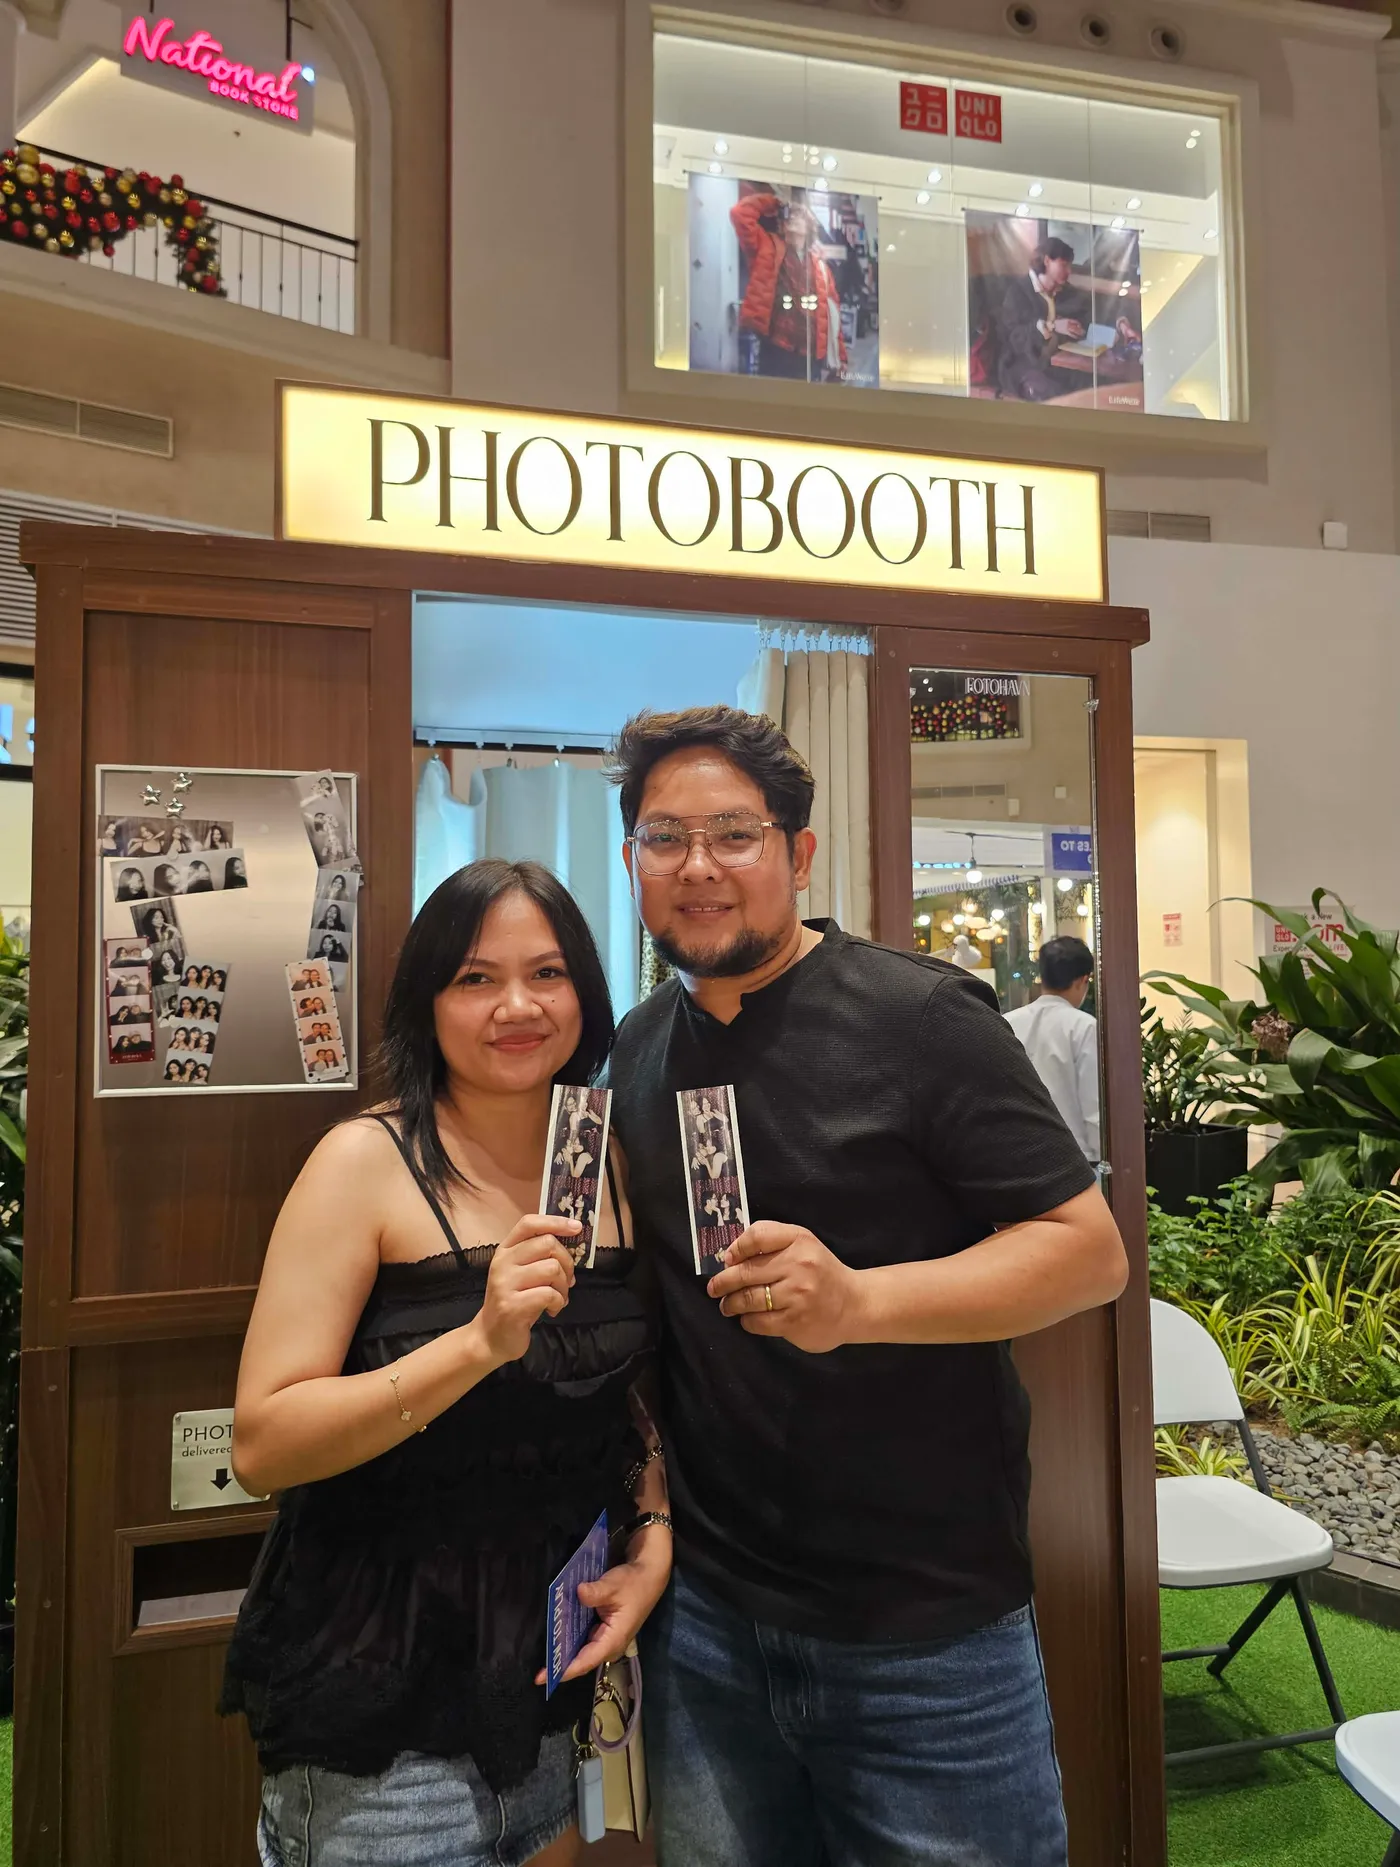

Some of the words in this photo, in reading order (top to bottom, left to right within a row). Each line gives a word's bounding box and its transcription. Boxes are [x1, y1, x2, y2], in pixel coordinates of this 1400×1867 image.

[123, 16, 302, 102] National
[208, 80, 250, 104] BOOK
[252, 95, 299, 121] STORE
[959, 95, 996, 117] UNI
[960, 115, 998, 137] QLO
[366, 418, 1038, 576] PHOTOBOOTH
[554, 1582, 564, 1621] PLAY
[553, 1619, 562, 1645] TO
[552, 1644, 562, 1680] HOW
